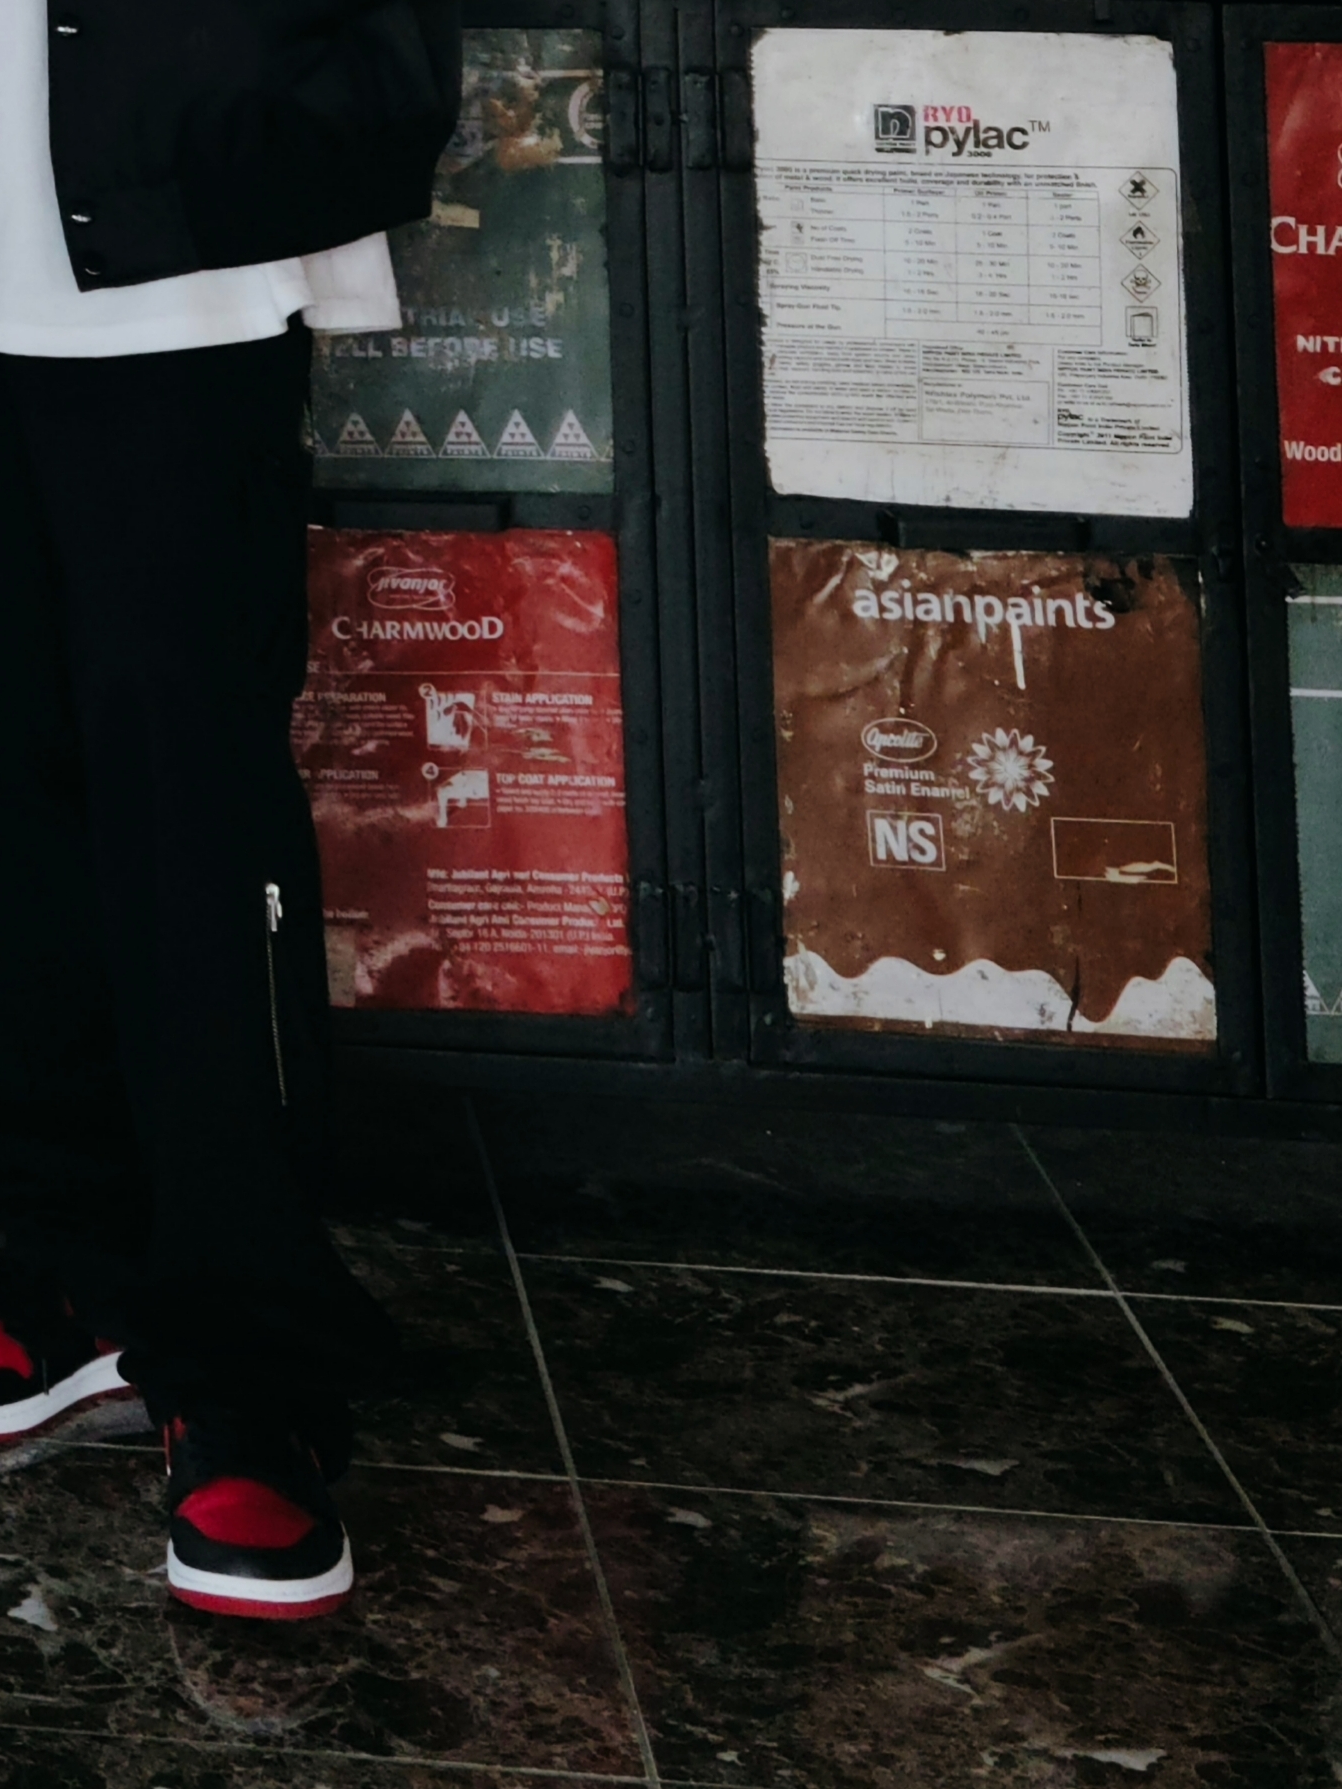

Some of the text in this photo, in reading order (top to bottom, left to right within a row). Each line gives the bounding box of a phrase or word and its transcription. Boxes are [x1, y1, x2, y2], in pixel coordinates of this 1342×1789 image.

[923, 119, 1029, 157] pylac
[510, 338, 563, 359] USE
[852, 578, 1116, 643] asianpaints
[331, 616, 505, 641] CHARMWOOD
[492, 692, 593, 706] STAIN APPLICATION
[496, 773, 616, 787] TOP COAT APPLICATION
[863, 762, 935, 781] Premium
[864, 779, 970, 800] Satin Enamel
[874, 817, 938, 864] NS
[532, 870, 580, 881] Consumer
[582, 872, 624, 884] Products
[512, 915, 559, 926] Consumer
